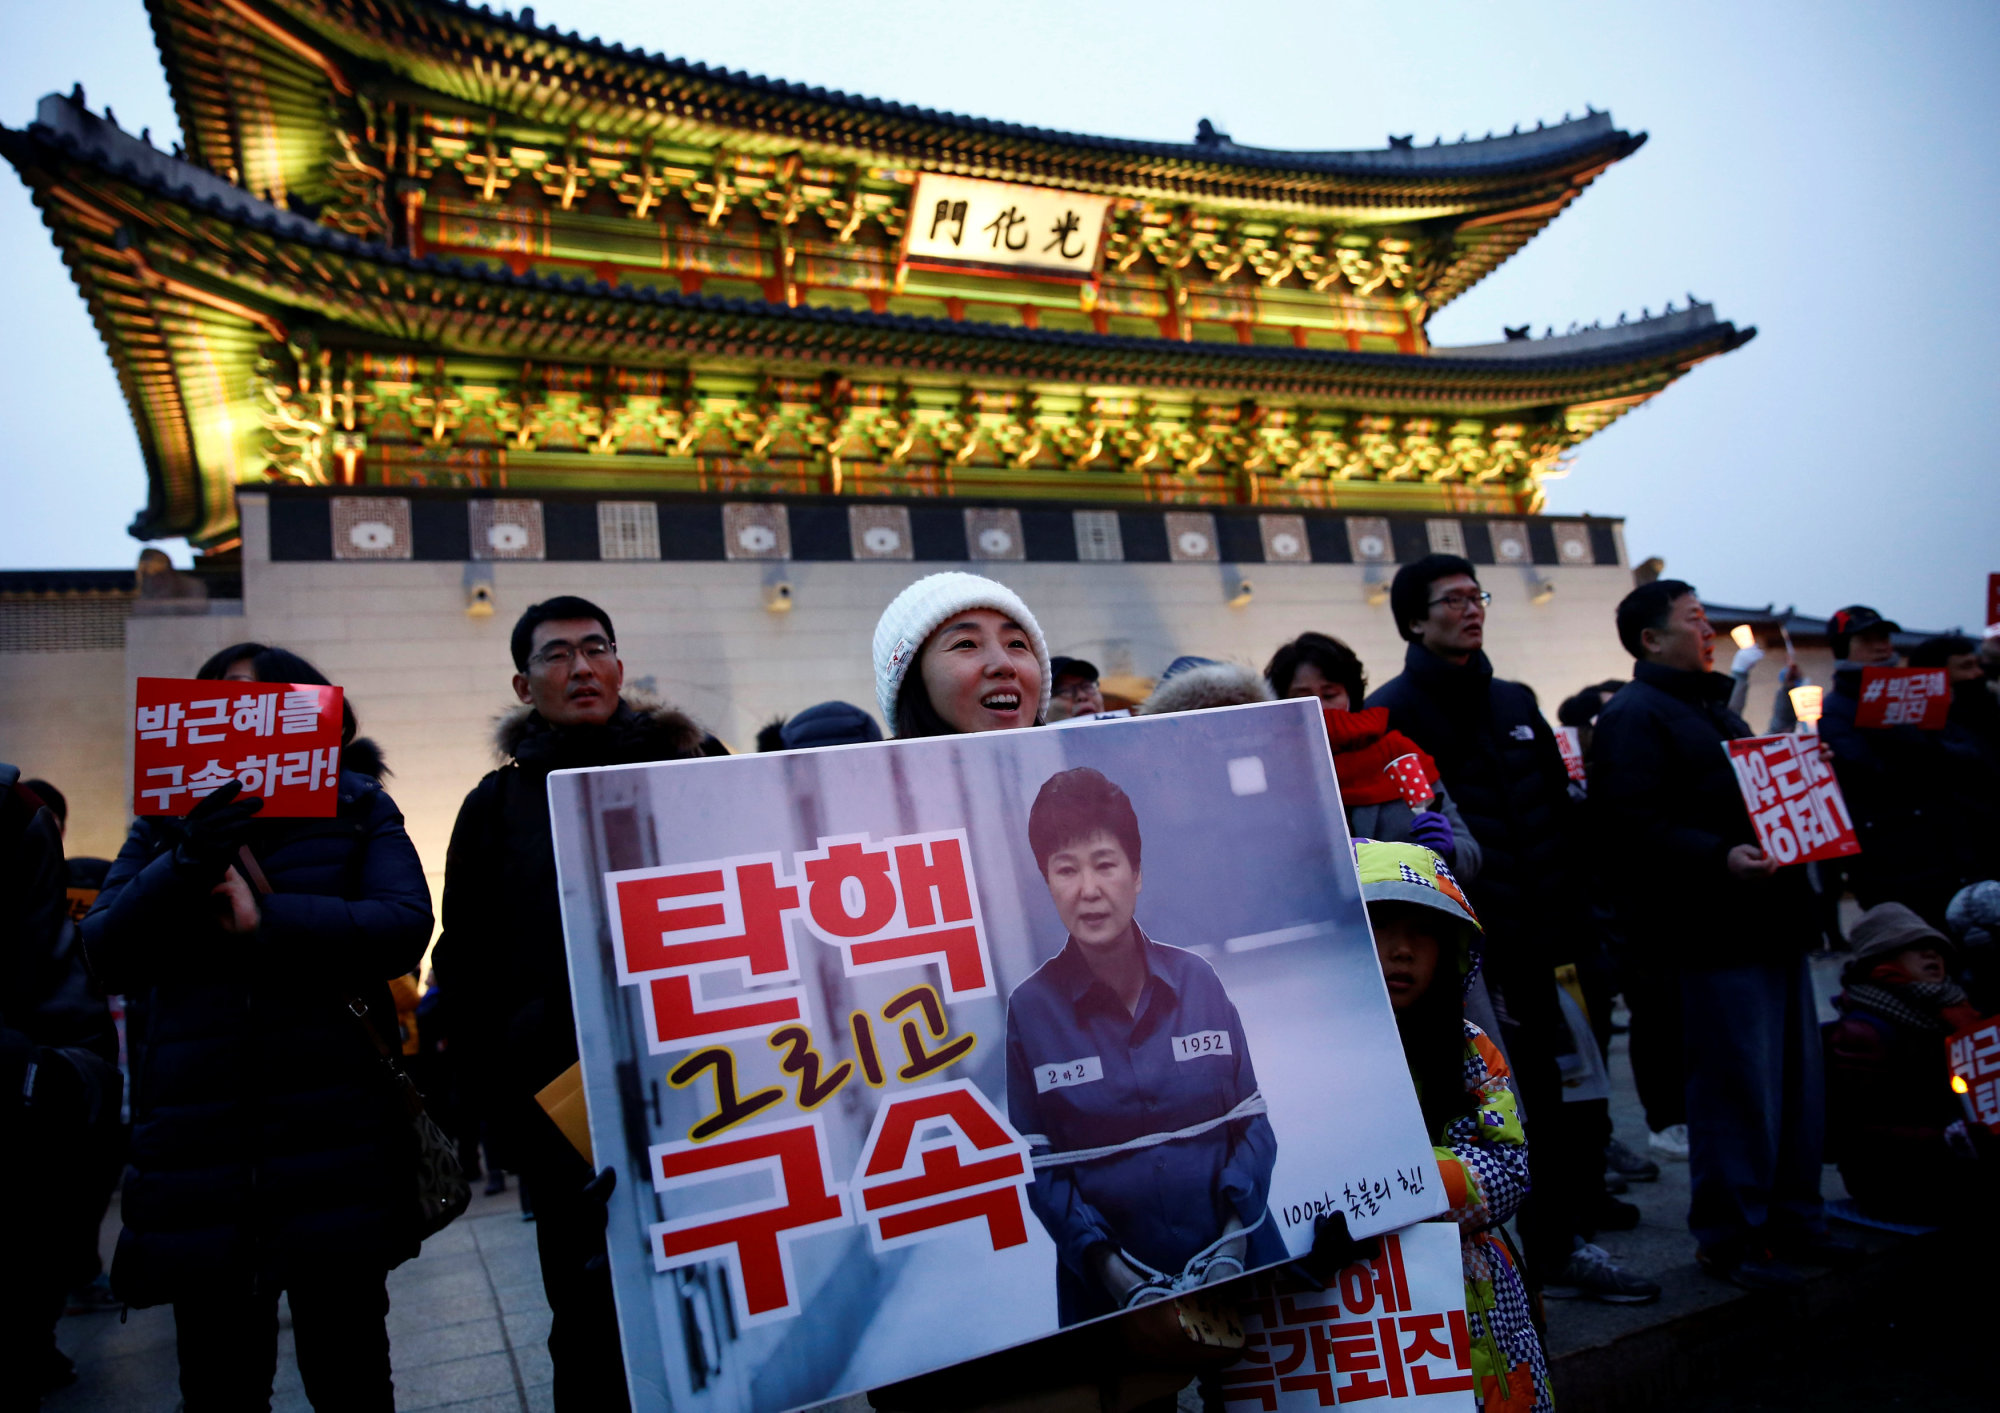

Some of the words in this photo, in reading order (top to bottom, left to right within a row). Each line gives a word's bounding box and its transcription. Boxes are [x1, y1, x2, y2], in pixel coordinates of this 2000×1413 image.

[137, 689, 323, 748] 박근혜를
[141, 746, 340, 810] 구속하라!
[616, 838, 989, 1044] 탄핵
[668, 985, 975, 1140] 그리고
[1181, 1034, 1224, 1053] 1952
[660, 1088, 1029, 1316] 구속
[1343, 1177, 1392, 1220] 촛불의
[1397, 1165, 1425, 1195] 힘!
